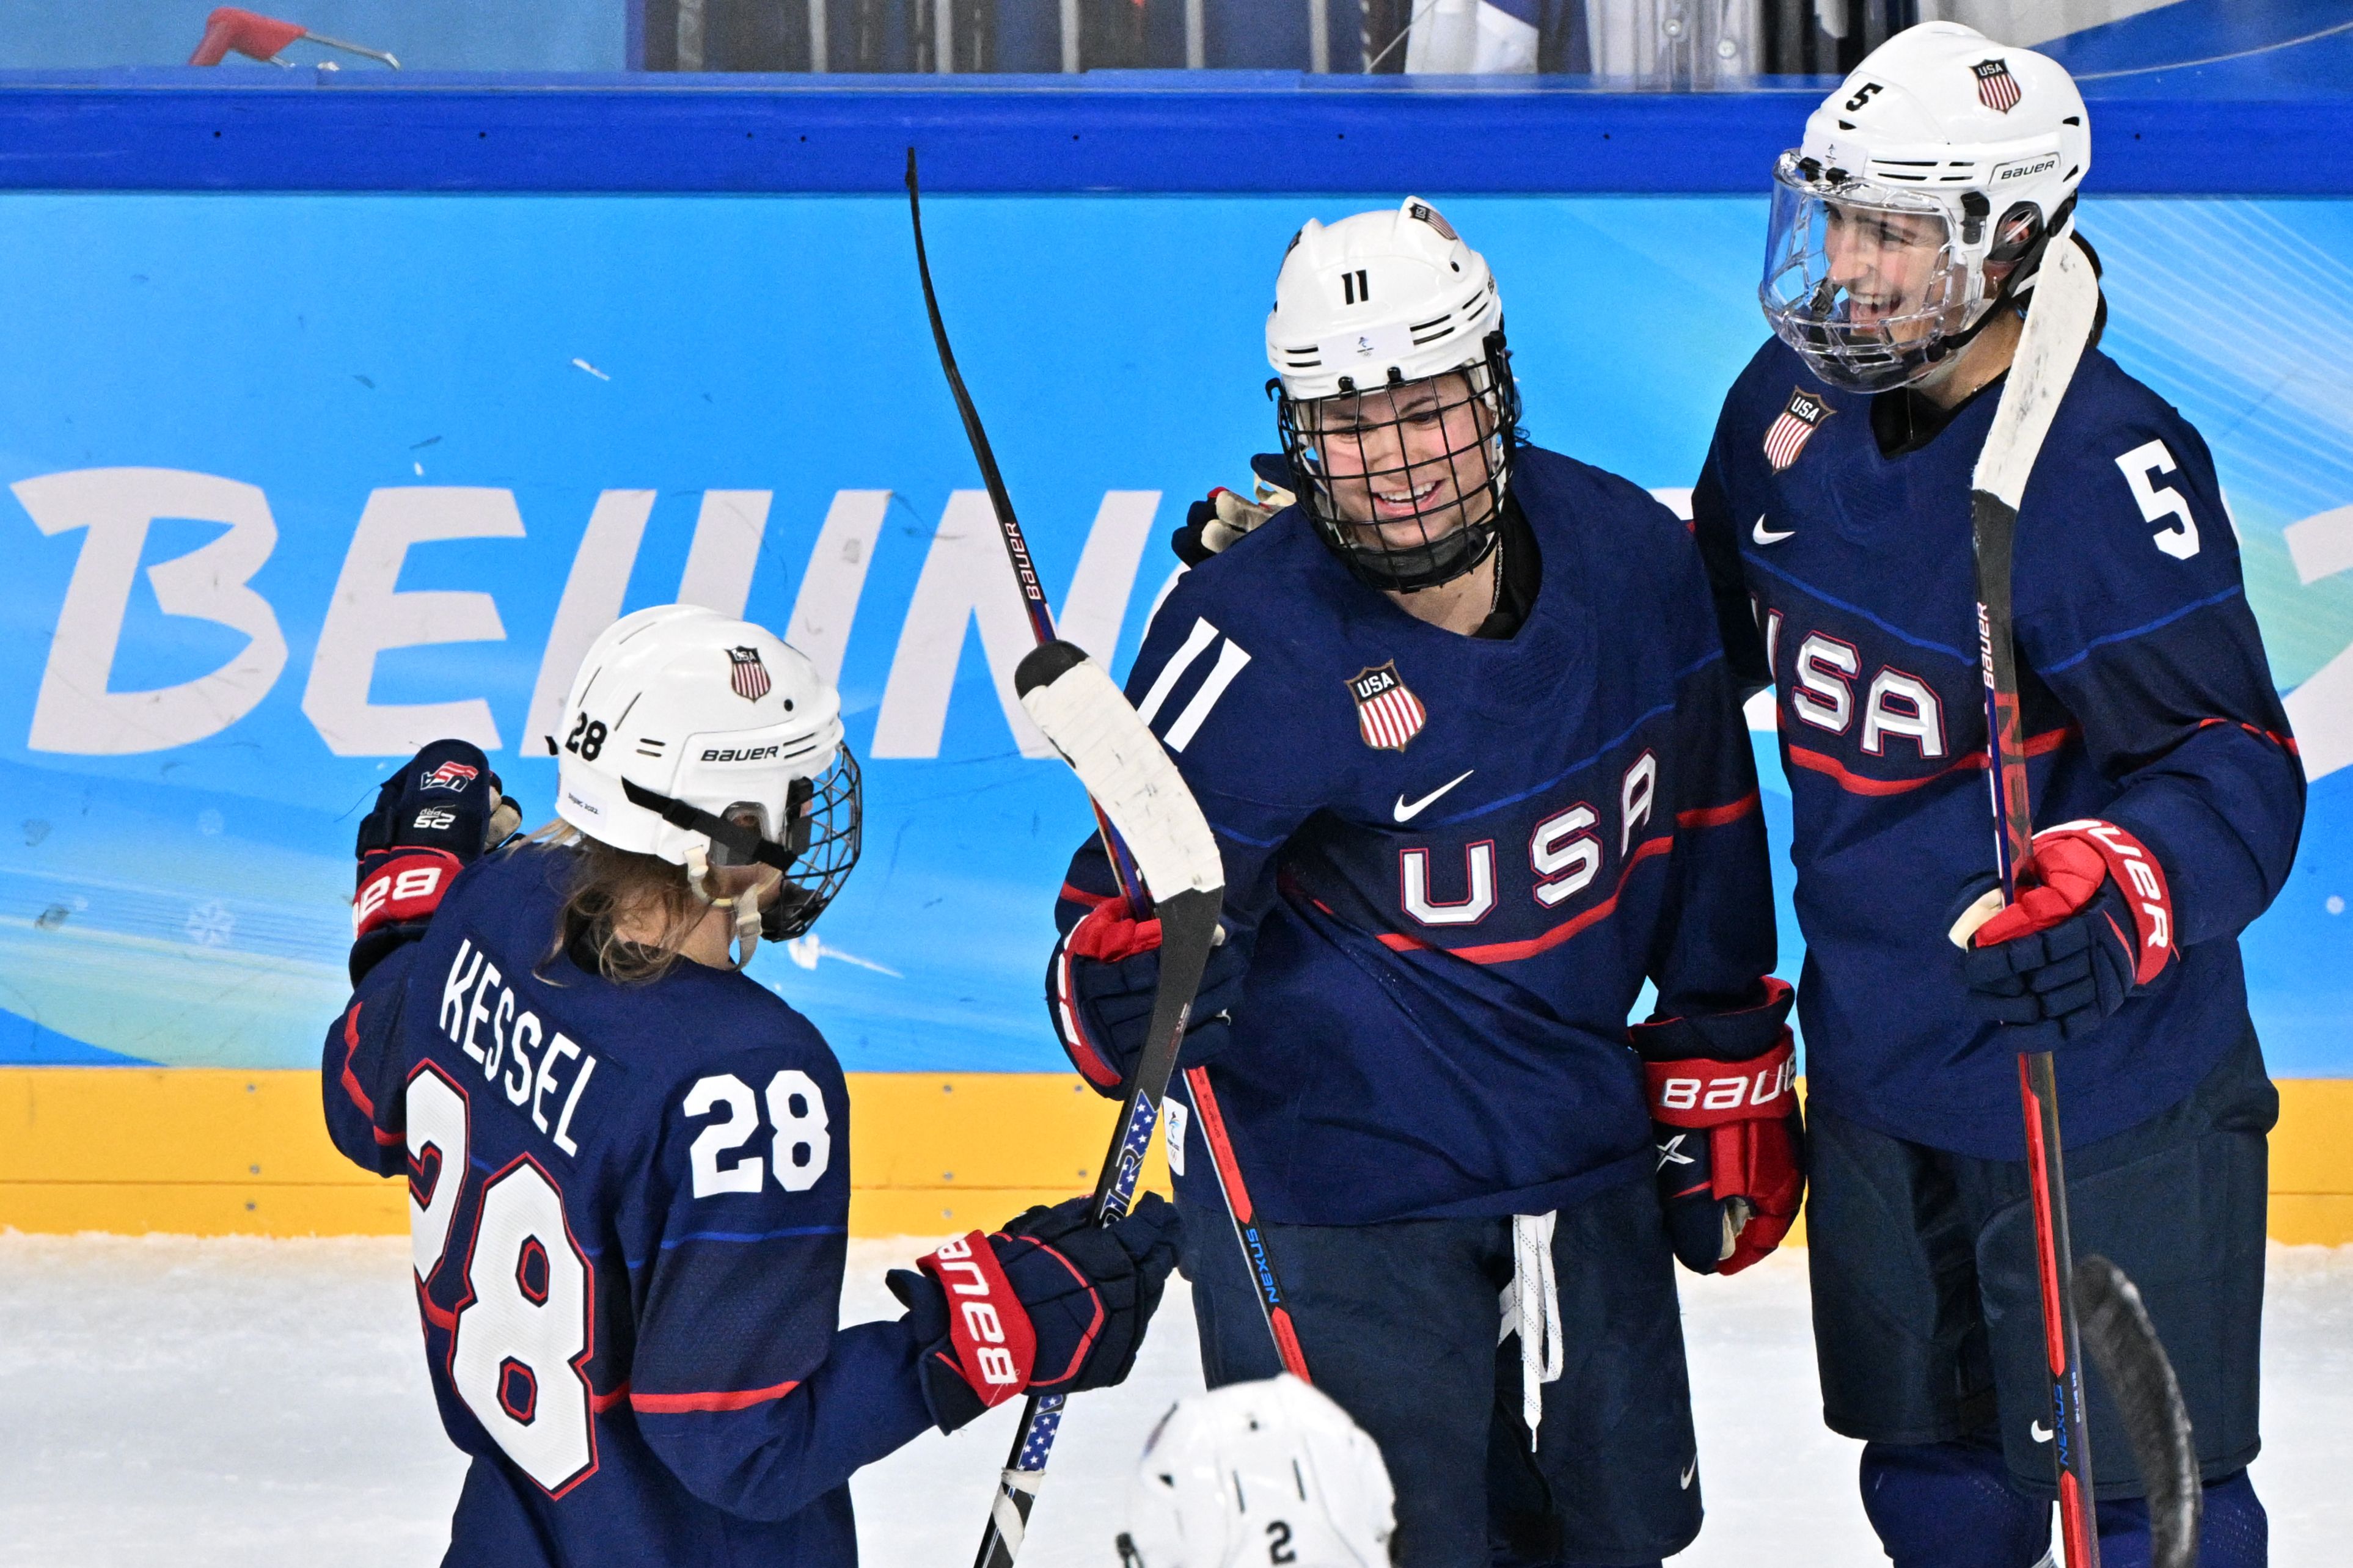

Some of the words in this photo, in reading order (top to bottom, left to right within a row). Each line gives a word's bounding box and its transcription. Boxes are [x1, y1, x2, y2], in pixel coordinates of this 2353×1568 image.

[1845, 82, 1884, 112] 5
[1976, 62, 2005, 76] USA
[2000, 159, 2056, 181] BAUER
[1341, 269, 1370, 305] 11
[1789, 395, 1819, 422] USA
[2116, 439, 2200, 560] 5
[1003, 522, 1042, 601] BAUER
[733, 650, 757, 662] USA
[1977, 602, 1994, 690] BAUER
[1137, 615, 1252, 753] 11
[1356, 671, 1396, 699] USA
[565, 711, 608, 762] 28
[700, 746, 779, 762] BAUER
[1399, 746, 1658, 926] USA
[439, 938, 596, 1157] KESSEL
[682, 1070, 831, 1199] 28
[406, 1057, 599, 1501] 28
[1245, 1228, 1279, 1304] NEXUS
[2054, 1384, 2069, 1466] NEXUS
[1265, 1519, 1297, 1565] 2
